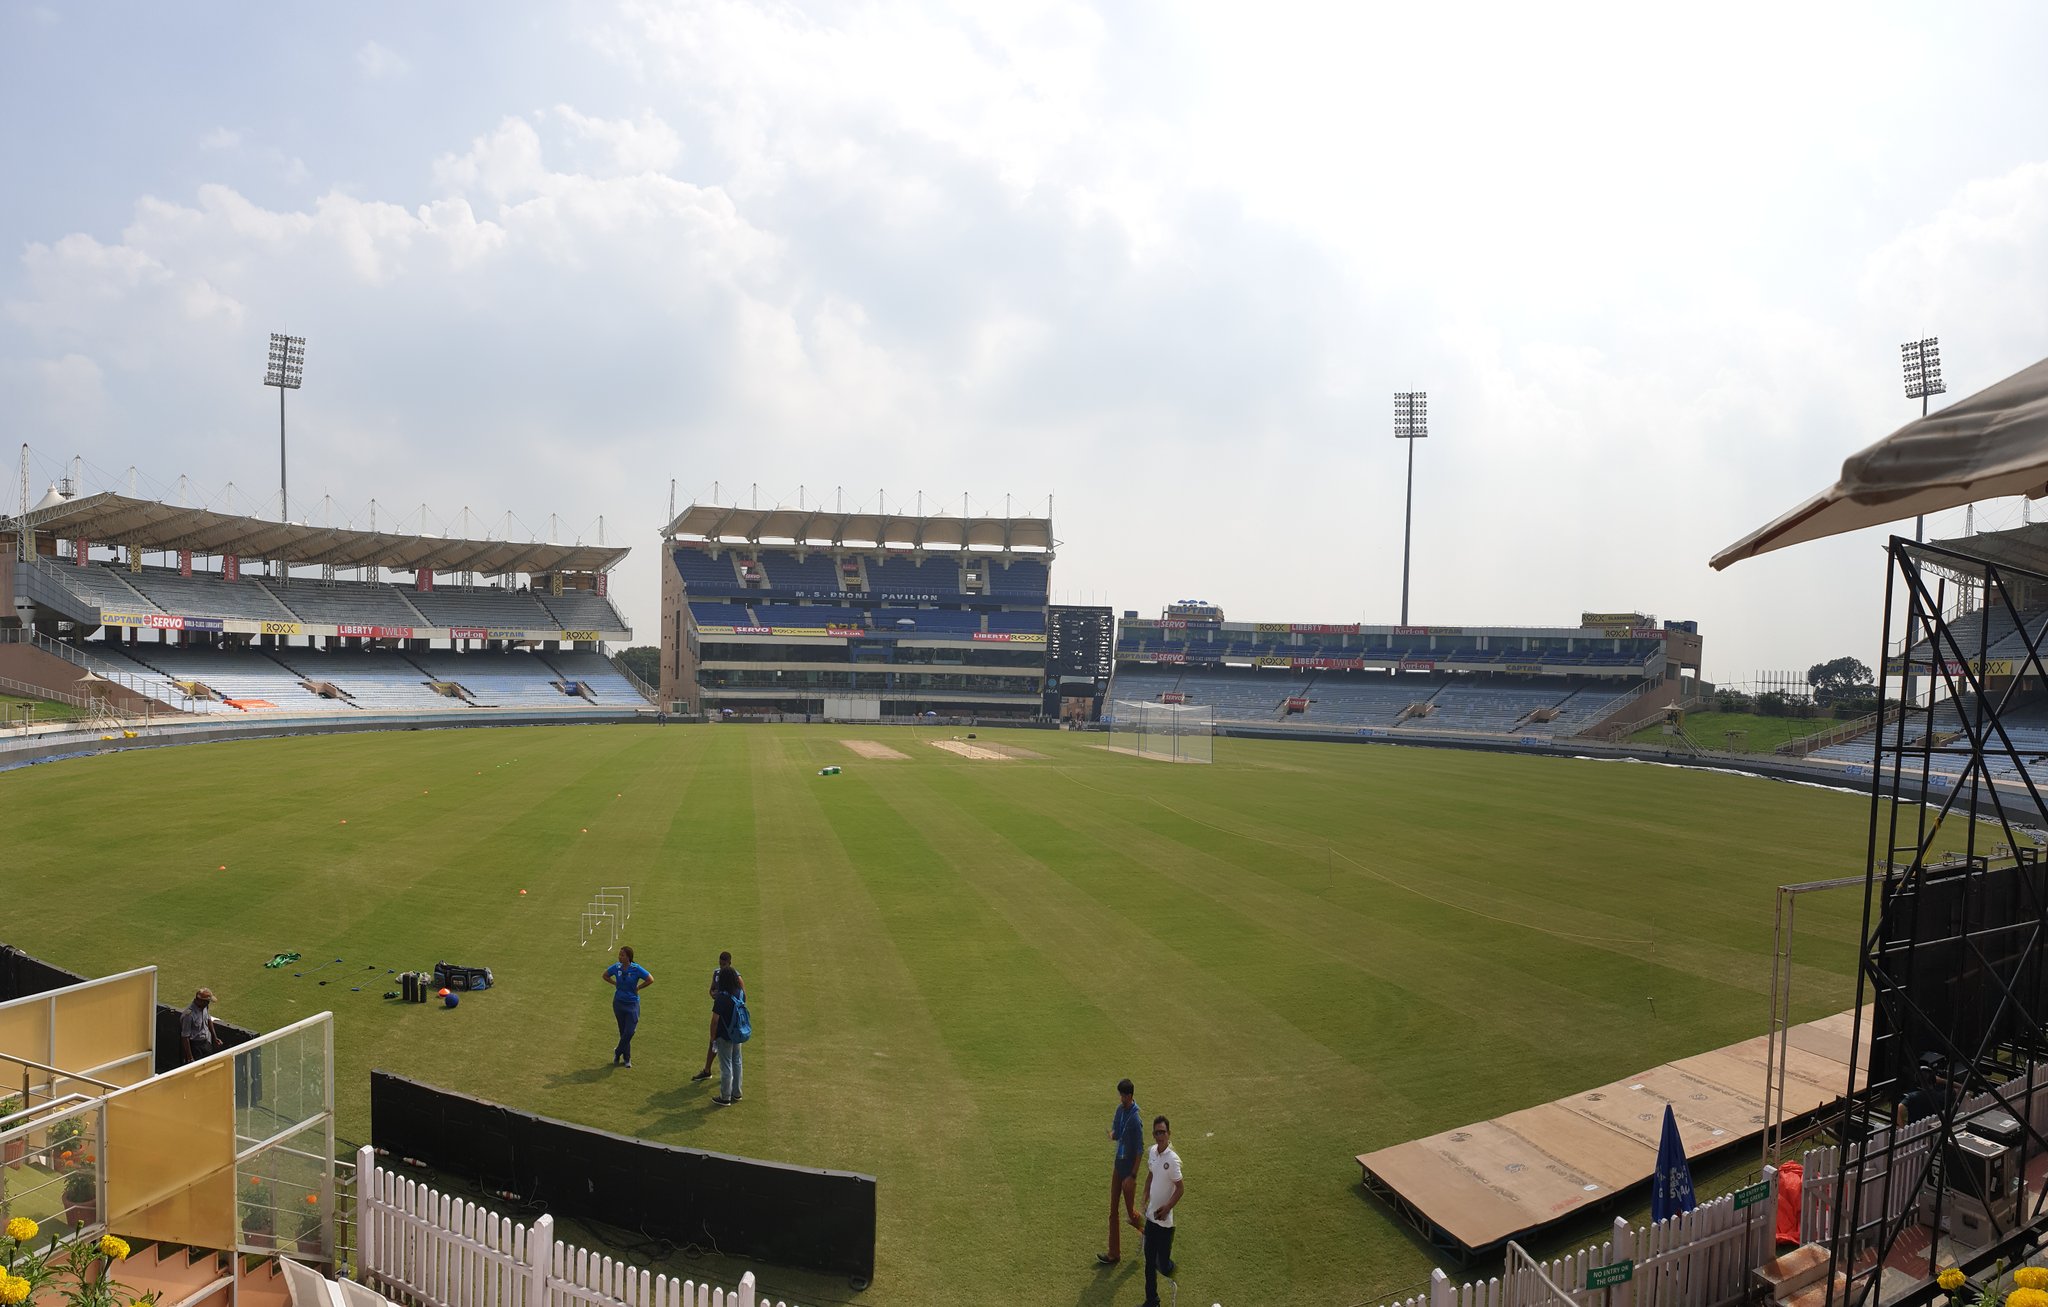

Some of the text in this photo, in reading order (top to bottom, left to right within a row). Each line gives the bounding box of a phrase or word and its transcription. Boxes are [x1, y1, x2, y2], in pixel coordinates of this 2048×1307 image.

[1168, 606, 1217, 615] CAPTAIN
[102, 614, 182, 628] CAPTAIN SERVO
[1582, 614, 1604, 622] ROXX
[266, 622, 294, 634] ROXX
[1160, 620, 1186, 628] SERVO
[340, 625, 408, 637] LIBERTY TWILLS
[566, 631, 592, 640] ROXX
[1333, 660, 1359, 668] TWILLS
[1604, 1266, 1620, 1276] ENTRY
[1607, 1274, 1626, 1283] GREEN
